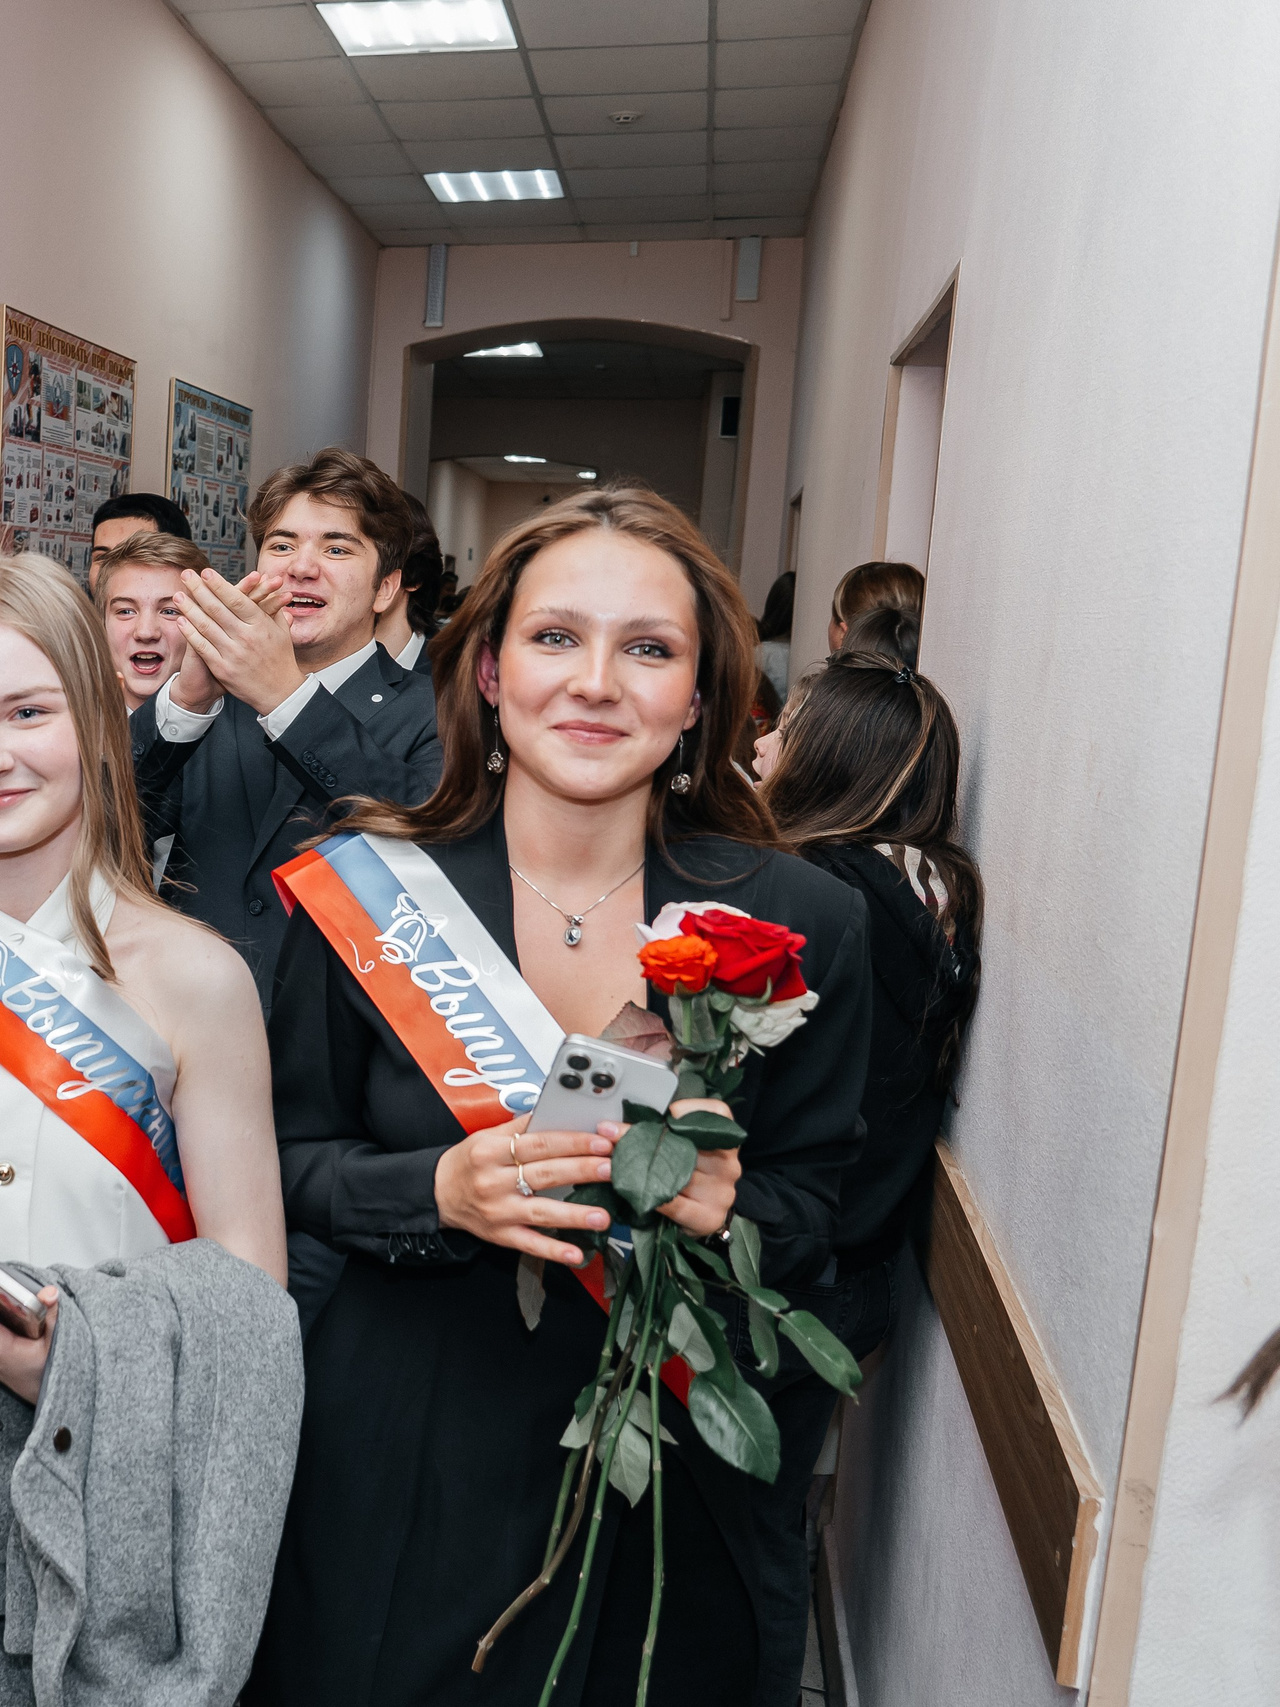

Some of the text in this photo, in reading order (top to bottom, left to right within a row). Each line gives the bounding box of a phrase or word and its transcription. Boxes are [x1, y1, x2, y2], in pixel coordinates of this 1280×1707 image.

[8, 318, 32, 343] УМЕЙ
[35, 329, 89, 364] ДЕЙСТВОВАТЬ
[91, 352, 106, 371] ПРИ
